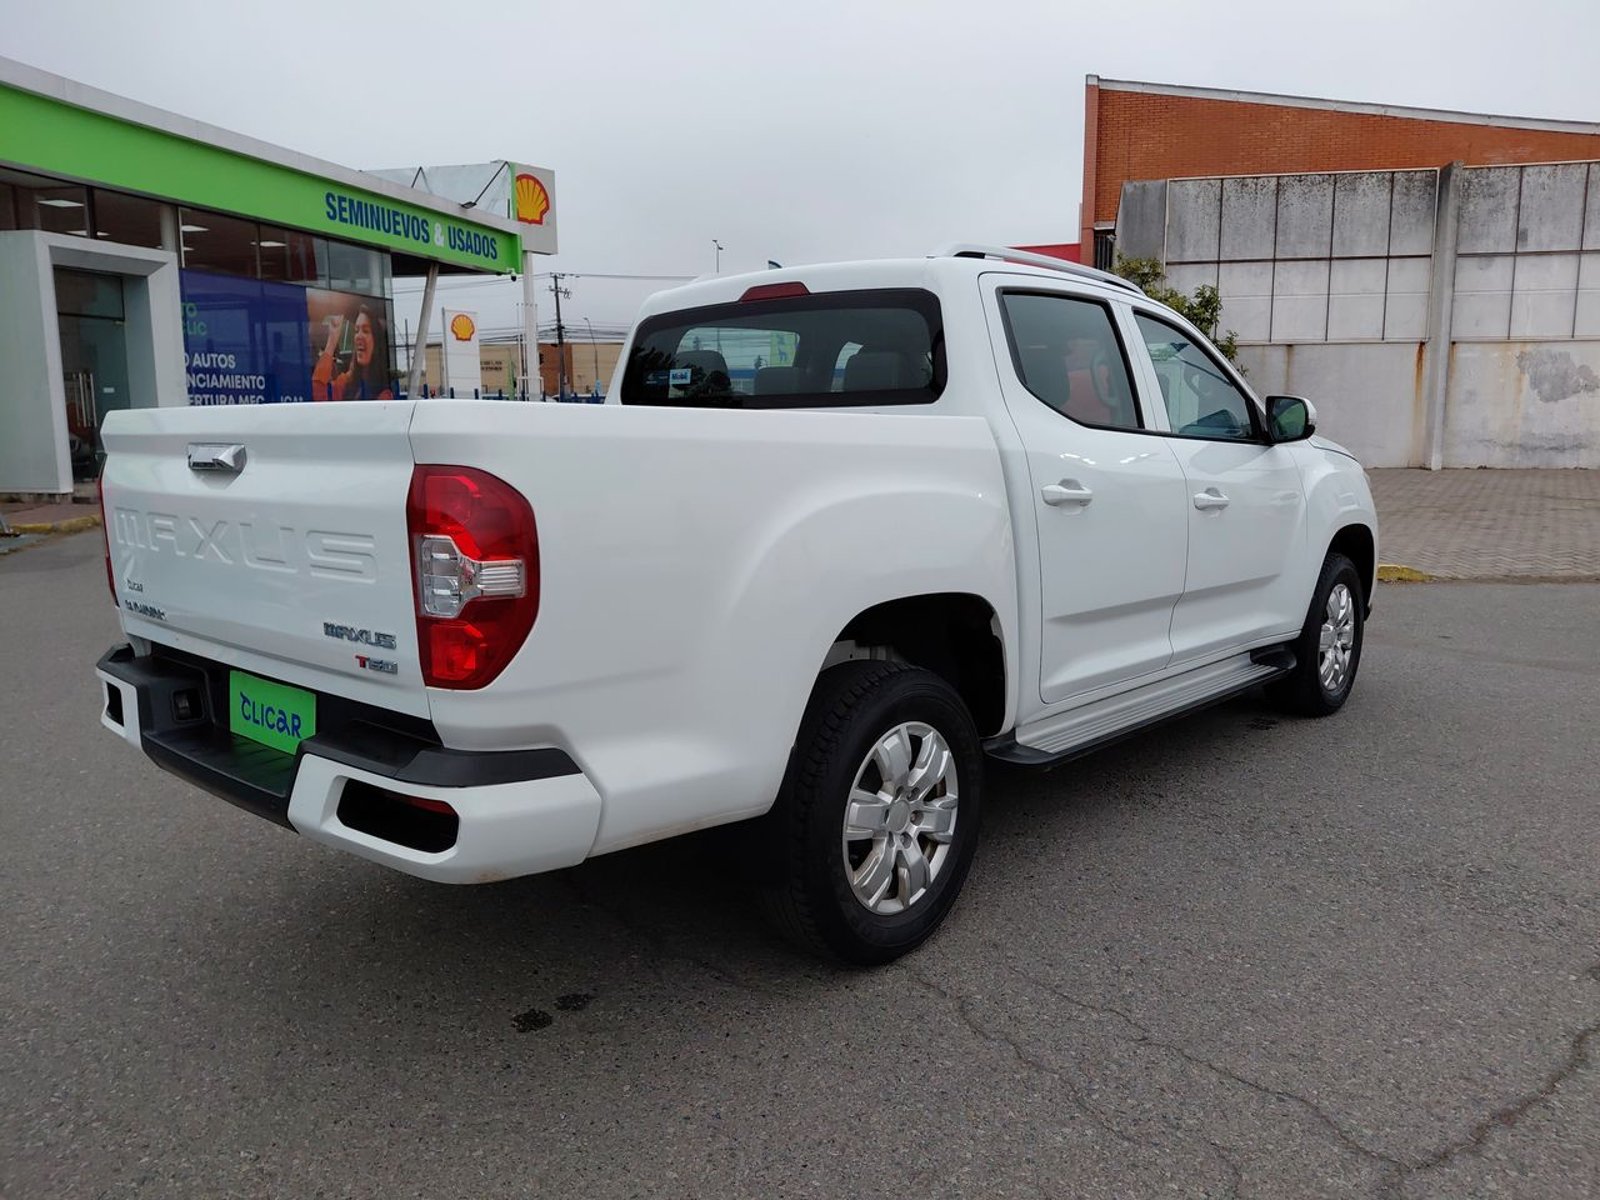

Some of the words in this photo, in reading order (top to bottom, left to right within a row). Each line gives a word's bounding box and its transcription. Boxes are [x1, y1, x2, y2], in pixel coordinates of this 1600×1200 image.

[325, 192, 430, 244] SEMINUEVOS
[434, 223, 444, 247] &
[447, 226, 498, 260] USADOS
[192, 353, 236, 369] AUTOS
[113, 506, 377, 584] MAXUS
[323, 622, 397, 650] MAXUS
